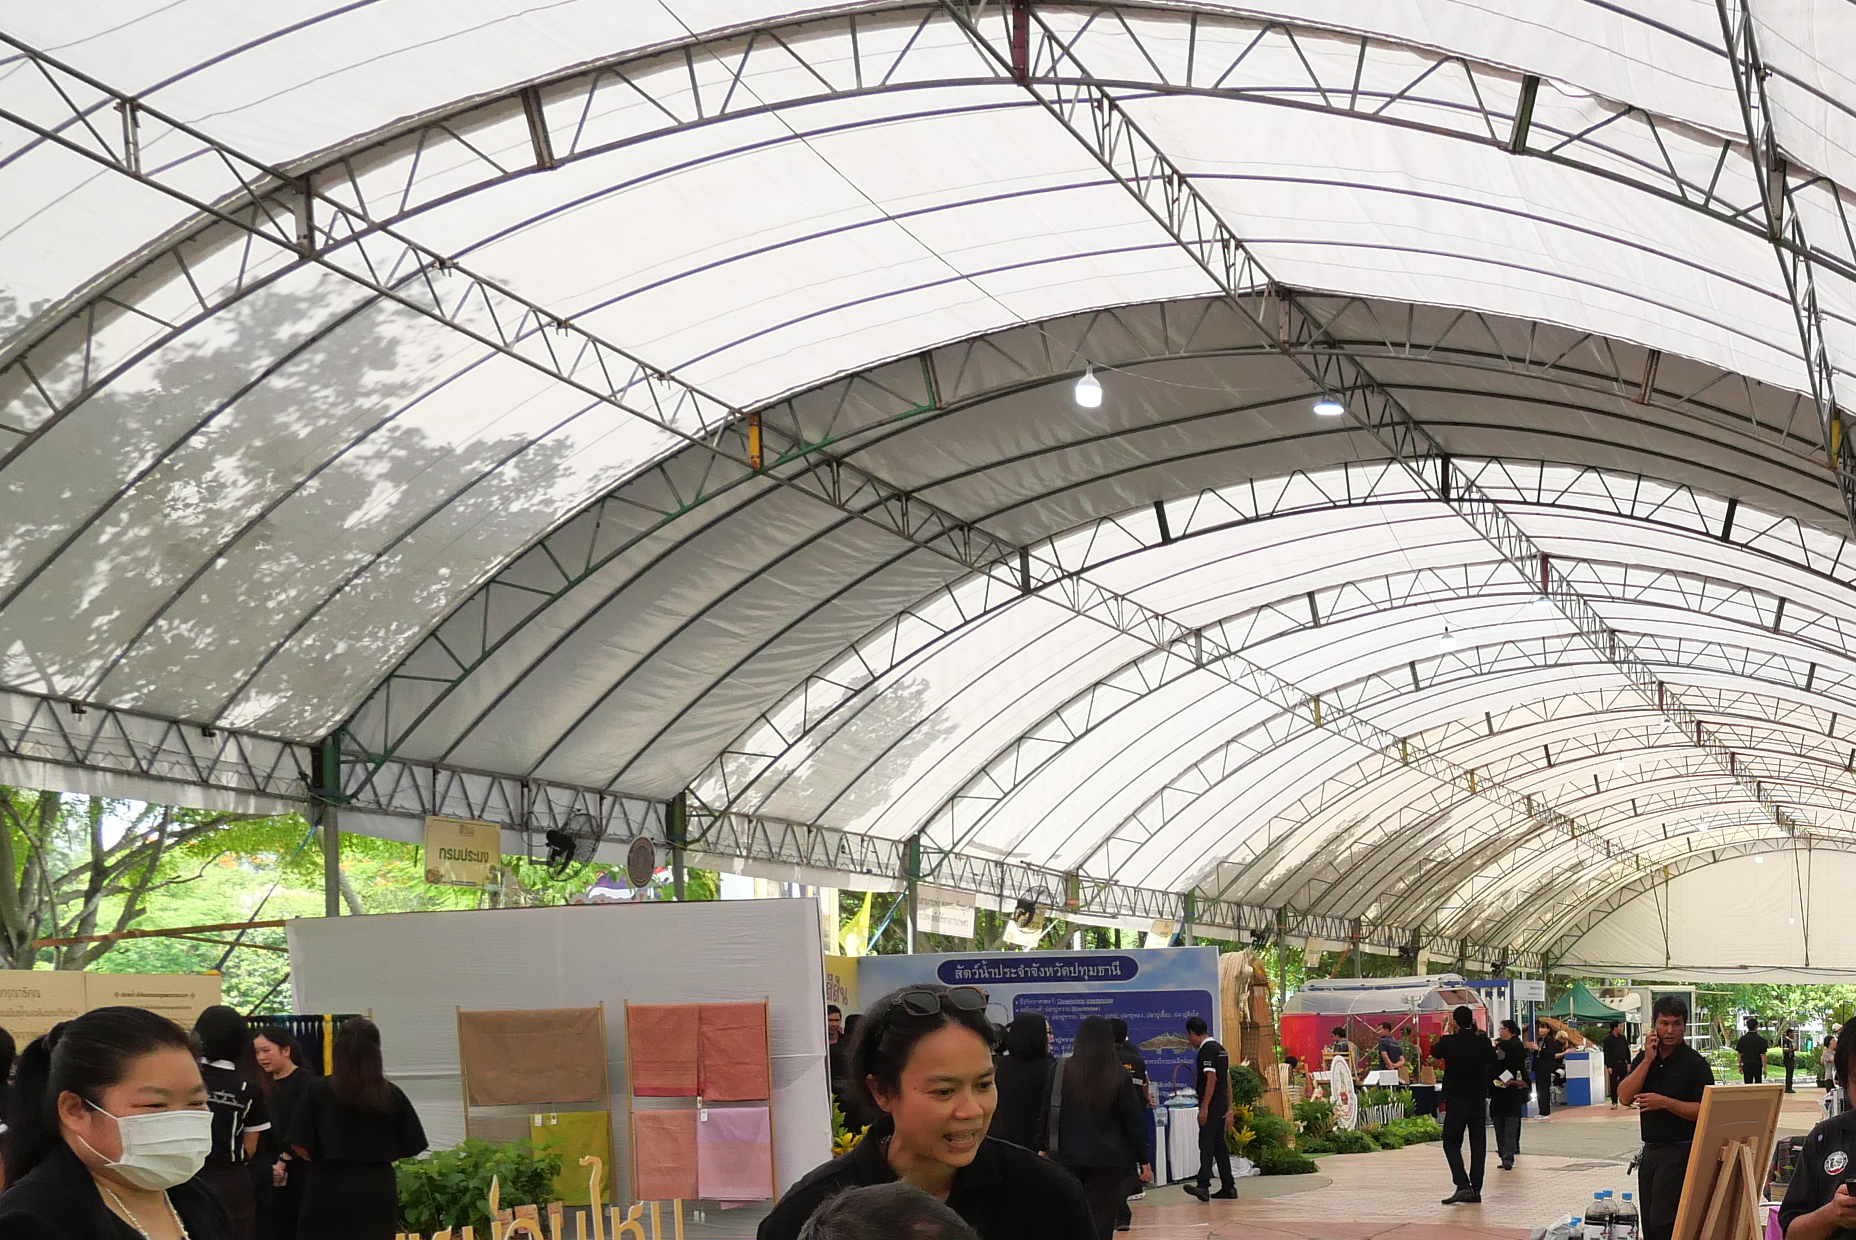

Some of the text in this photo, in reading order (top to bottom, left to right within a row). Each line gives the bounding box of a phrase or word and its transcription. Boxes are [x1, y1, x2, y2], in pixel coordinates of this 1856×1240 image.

[438, 846, 490, 864] กรมประมง
[954, 960, 1121, 982] สัตว์น้ำประจำจังหวัดปทุมธานี
